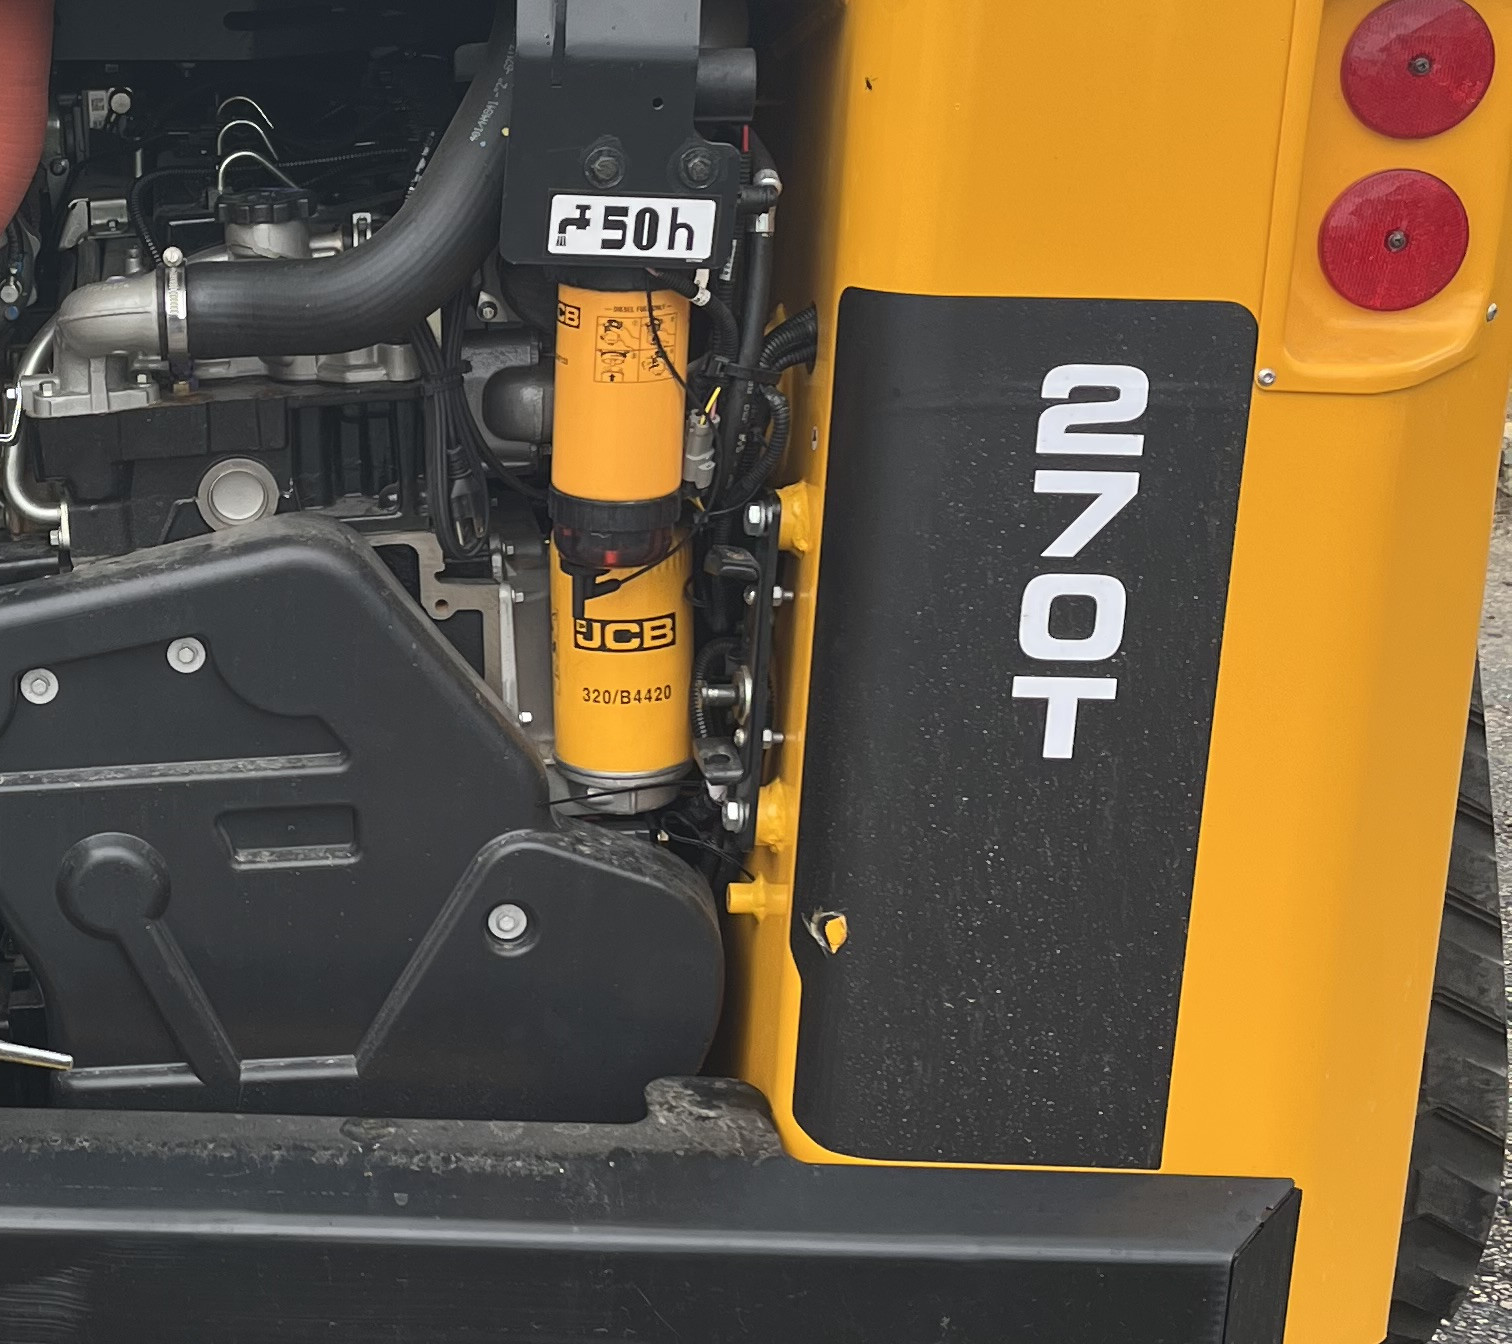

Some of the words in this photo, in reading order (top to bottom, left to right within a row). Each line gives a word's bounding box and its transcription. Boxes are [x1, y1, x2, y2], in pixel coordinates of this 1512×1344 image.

[556, 300, 581, 329] CB
[1011, 362, 1150, 759] 270T
[575, 617, 675, 651] JCB
[581, 683, 673, 705] 320/B4420
